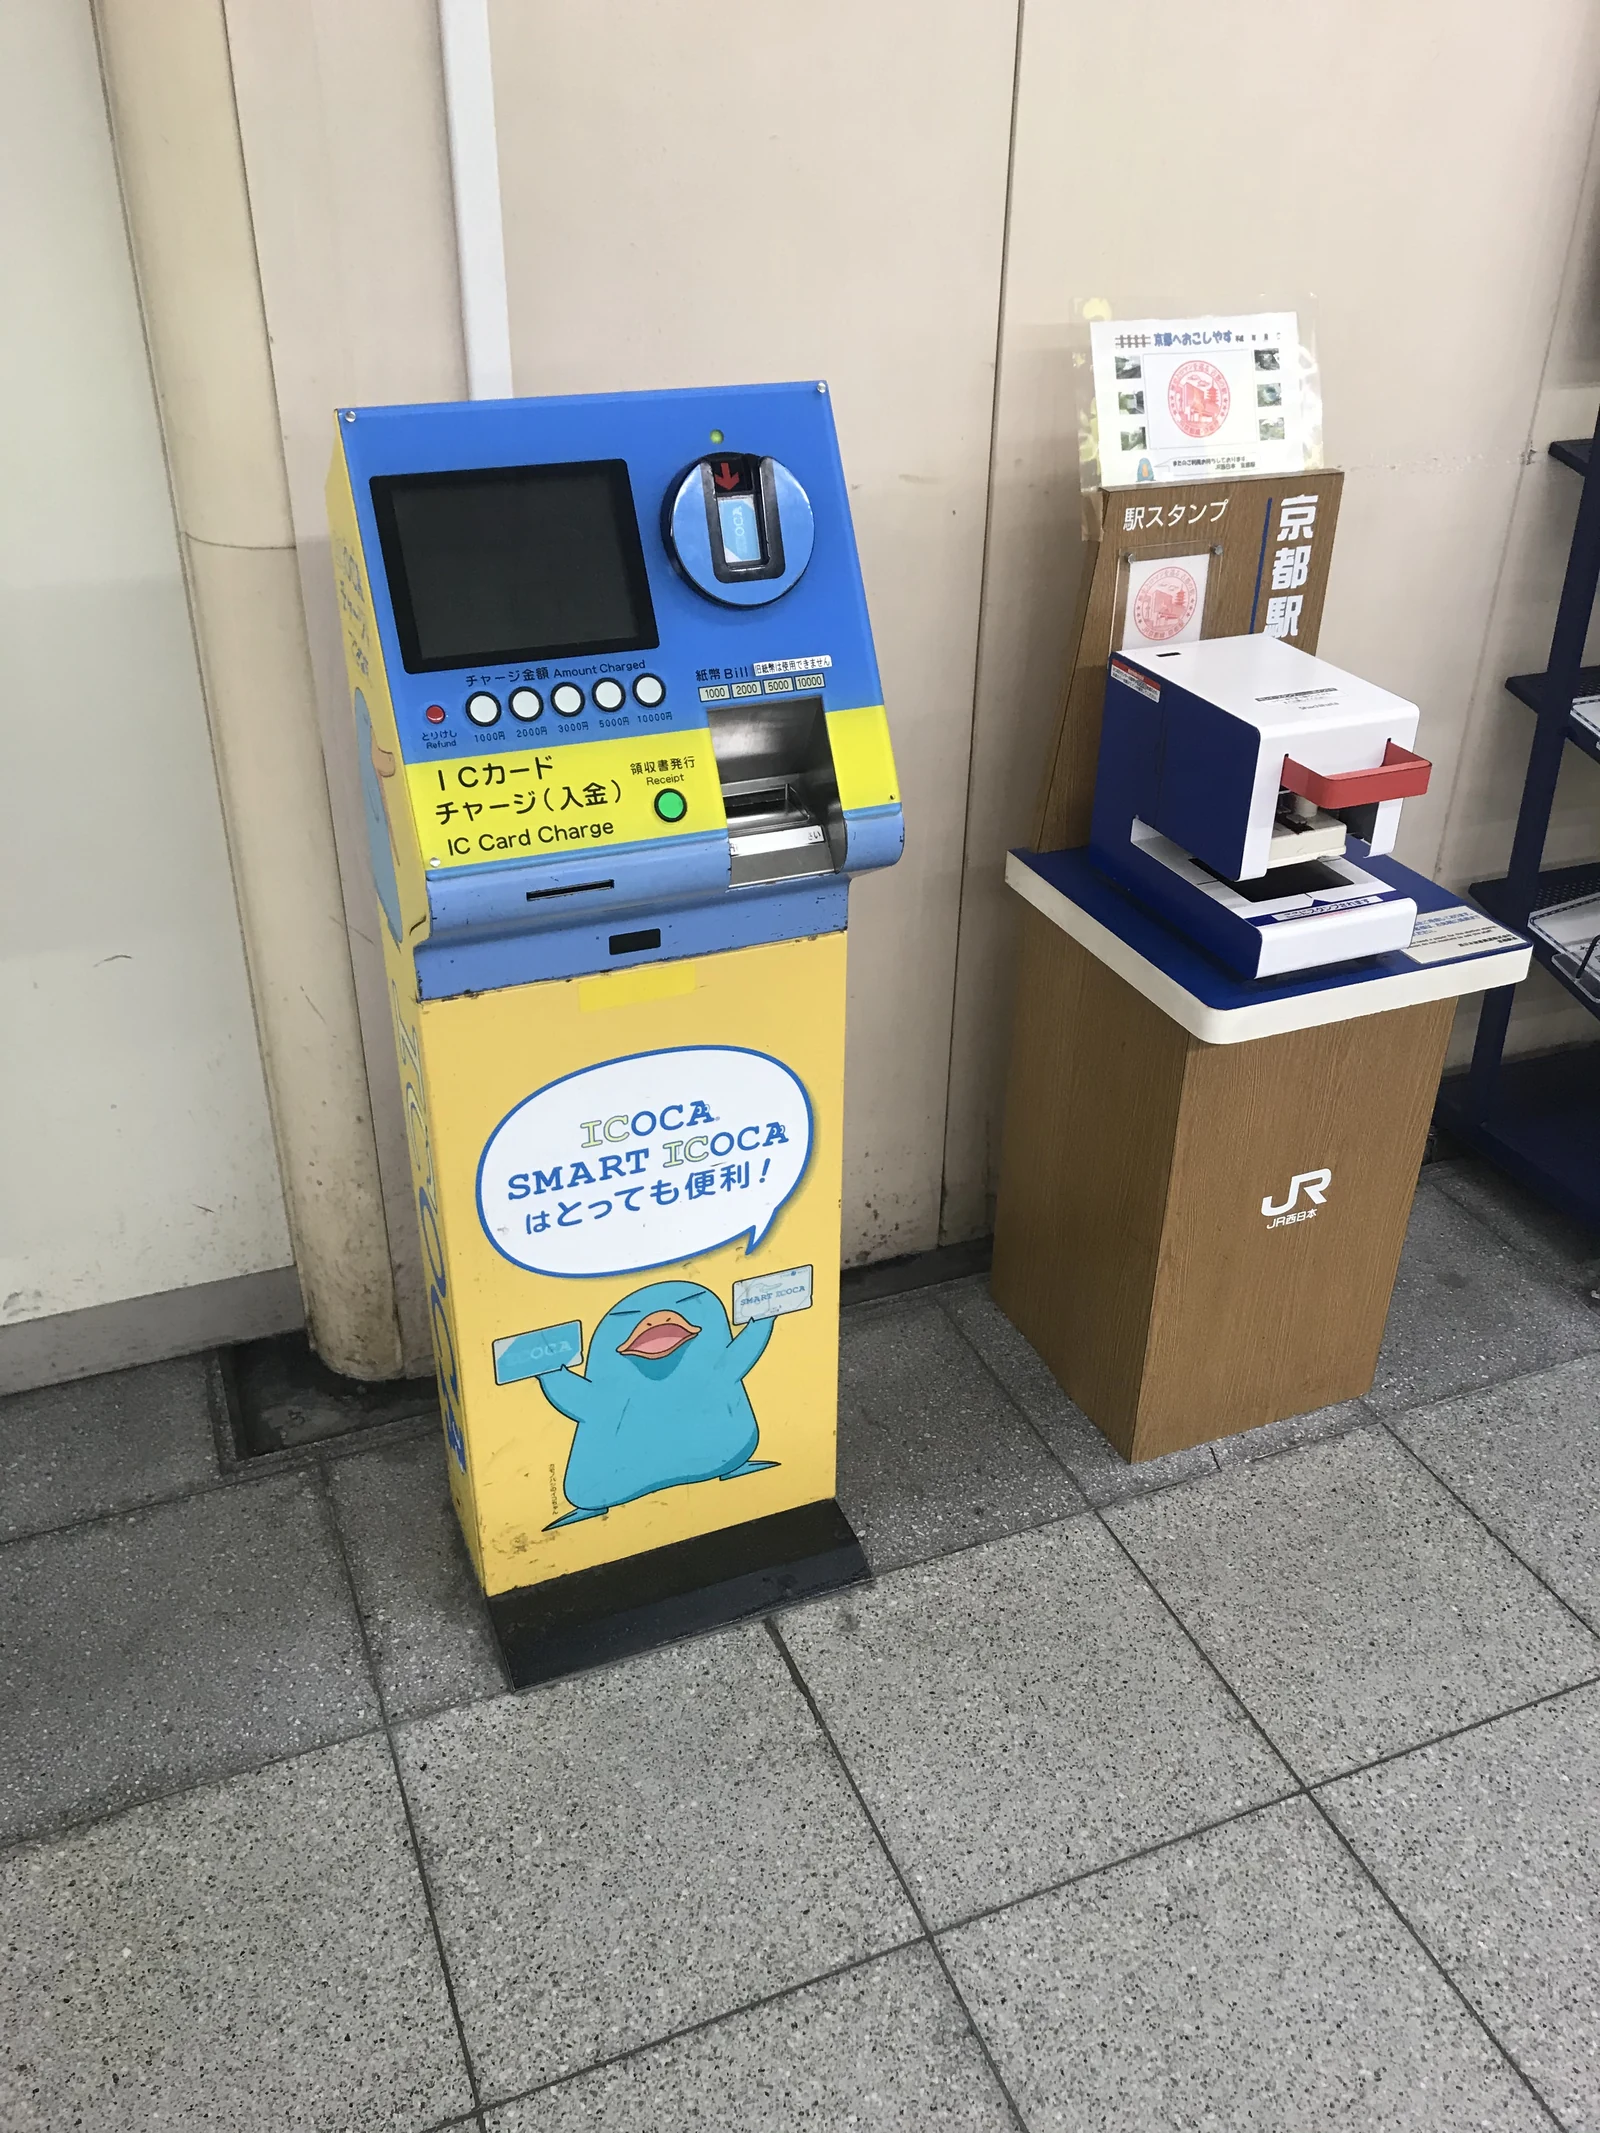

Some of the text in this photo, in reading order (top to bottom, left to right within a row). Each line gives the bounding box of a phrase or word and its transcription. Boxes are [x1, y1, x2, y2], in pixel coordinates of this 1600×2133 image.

[1153, 330, 1233, 348] 京都へおこしやす
[1123, 498, 1230, 532] 駅スタンプ
[1262, 493, 1319, 640] 京都駅
[465, 660, 646, 688] チャージ金額 Amount Charged
[695, 666, 749, 682] 紙幣 Bill
[705, 676, 822, 699] 1000 2000 5000 10000
[421, 730, 458, 742] とりけし
[474, 711, 673, 744] 1000円 2000円 3000円 5000円 10000円
[426, 740, 457, 750] Refund
[629, 755, 696, 776] 領収書発行
[646, 773, 685, 787] Receipt
[435, 778, 622, 825] チャージ（入金）
[447, 821, 614, 856] IC Card Charge
[580, 1100, 715, 1148] ICOCA
[508, 1122, 789, 1200] SMART ICOCA
[526, 1158, 771, 1235] はとっても便利！
[1261, 1168, 1332, 1217] JR
[1266, 1208, 1318, 1230] JR西日本
[740, 1285, 806, 1306] SMART ICOCA
